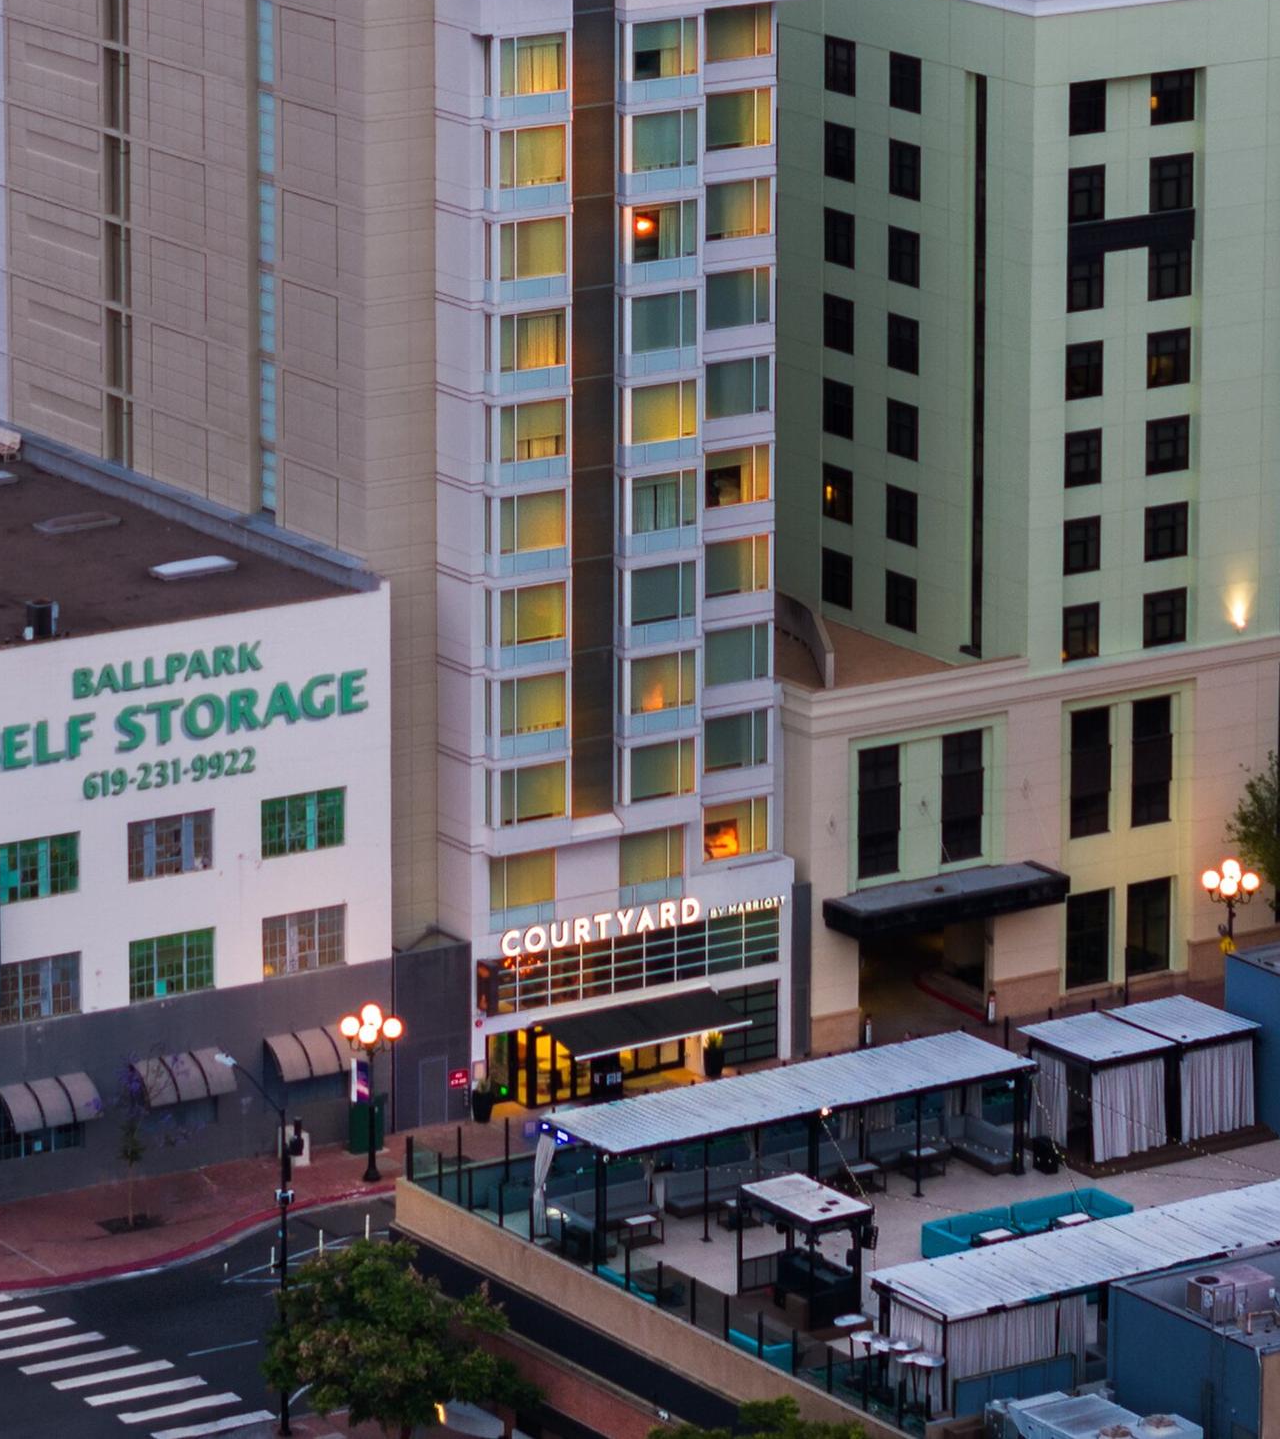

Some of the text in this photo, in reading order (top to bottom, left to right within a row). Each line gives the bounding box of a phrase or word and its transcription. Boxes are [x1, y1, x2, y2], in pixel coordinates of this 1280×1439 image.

[72, 640, 263, 699] BALLPARK
[114, 668, 368, 753] STORAGE
[82, 746, 256, 801] 619-231-9922
[501, 897, 701, 957] COURTYARD
[728, 895, 786, 915] MARRIOTT
